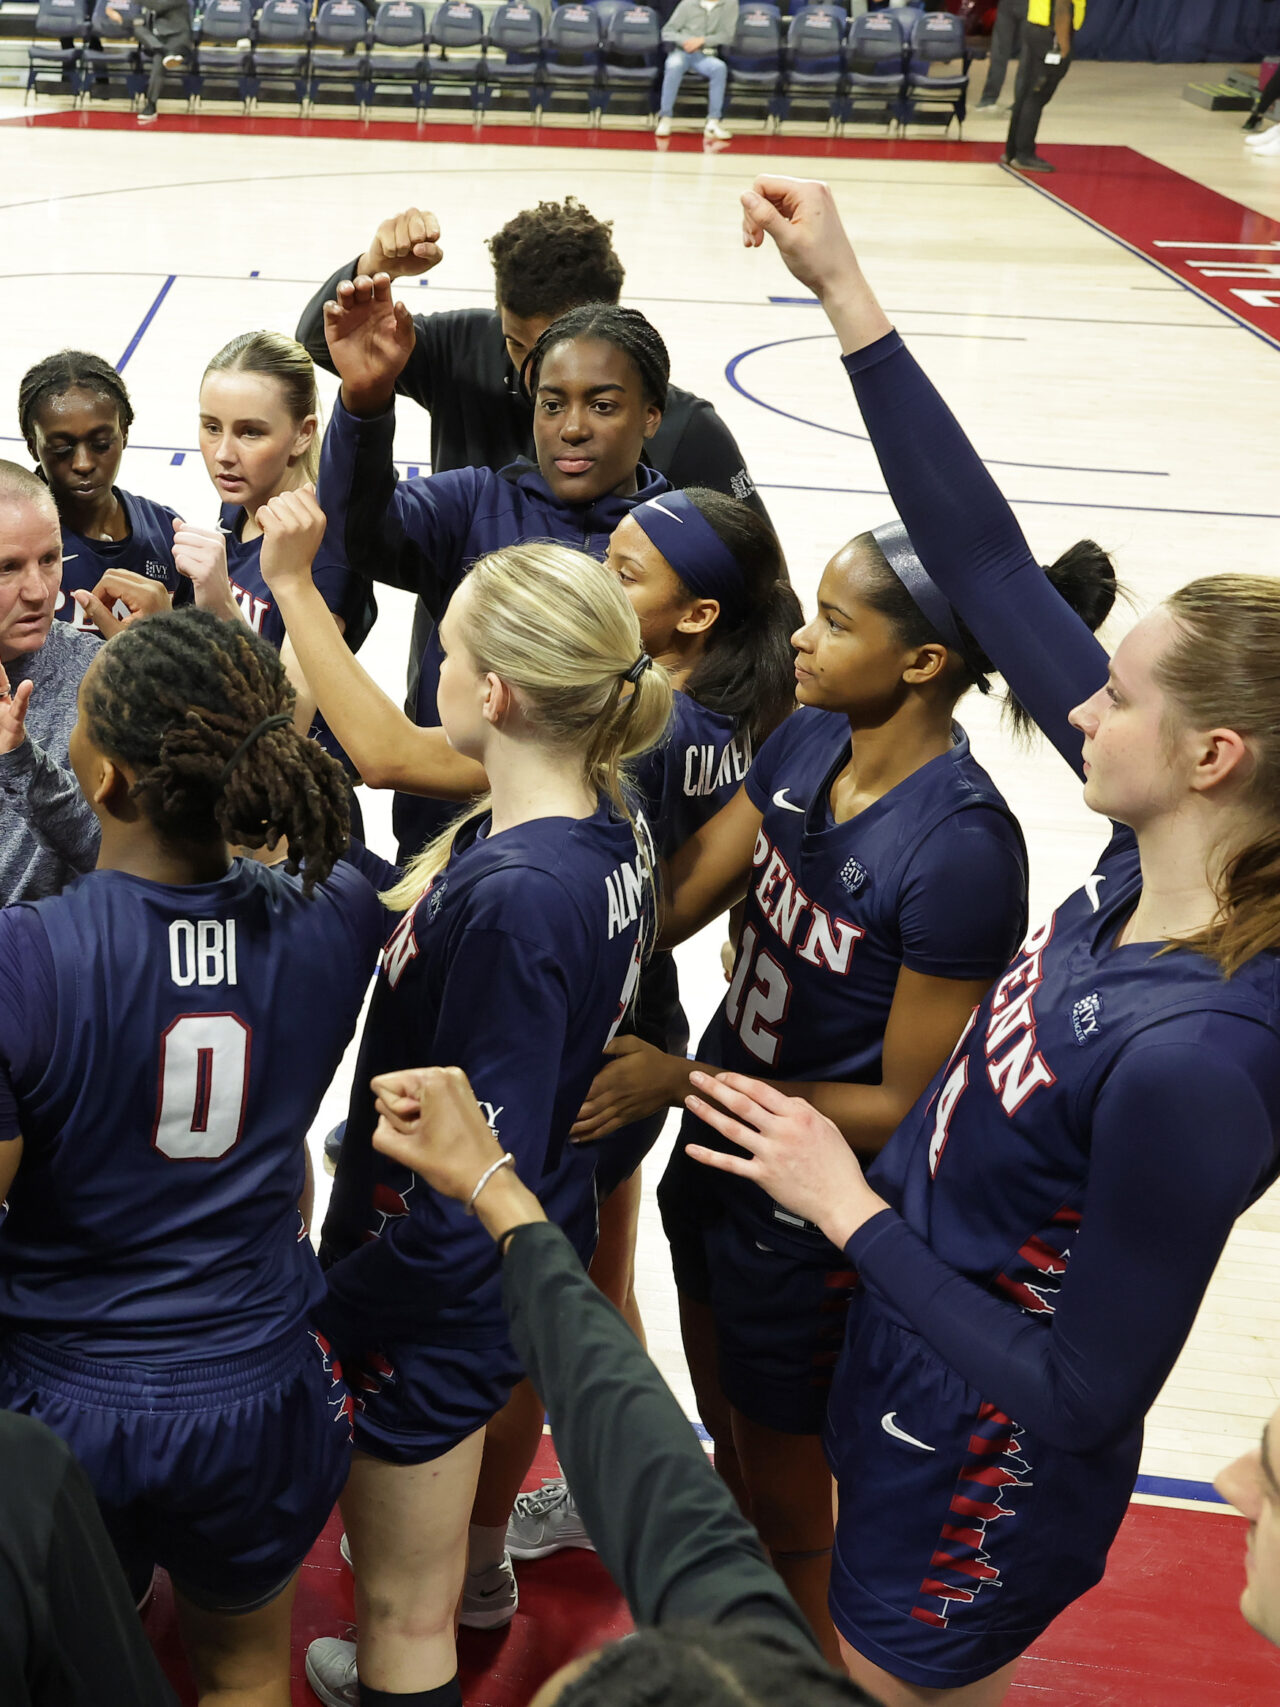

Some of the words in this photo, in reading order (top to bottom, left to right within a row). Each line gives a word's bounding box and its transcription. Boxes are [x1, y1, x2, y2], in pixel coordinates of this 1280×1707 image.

[848, 866, 865, 888] IVY
[169, 918, 237, 987] OBI
[725, 920, 793, 1069] 12
[985, 911, 1058, 1118] PENN
[1079, 1004, 1099, 1036] IVY
